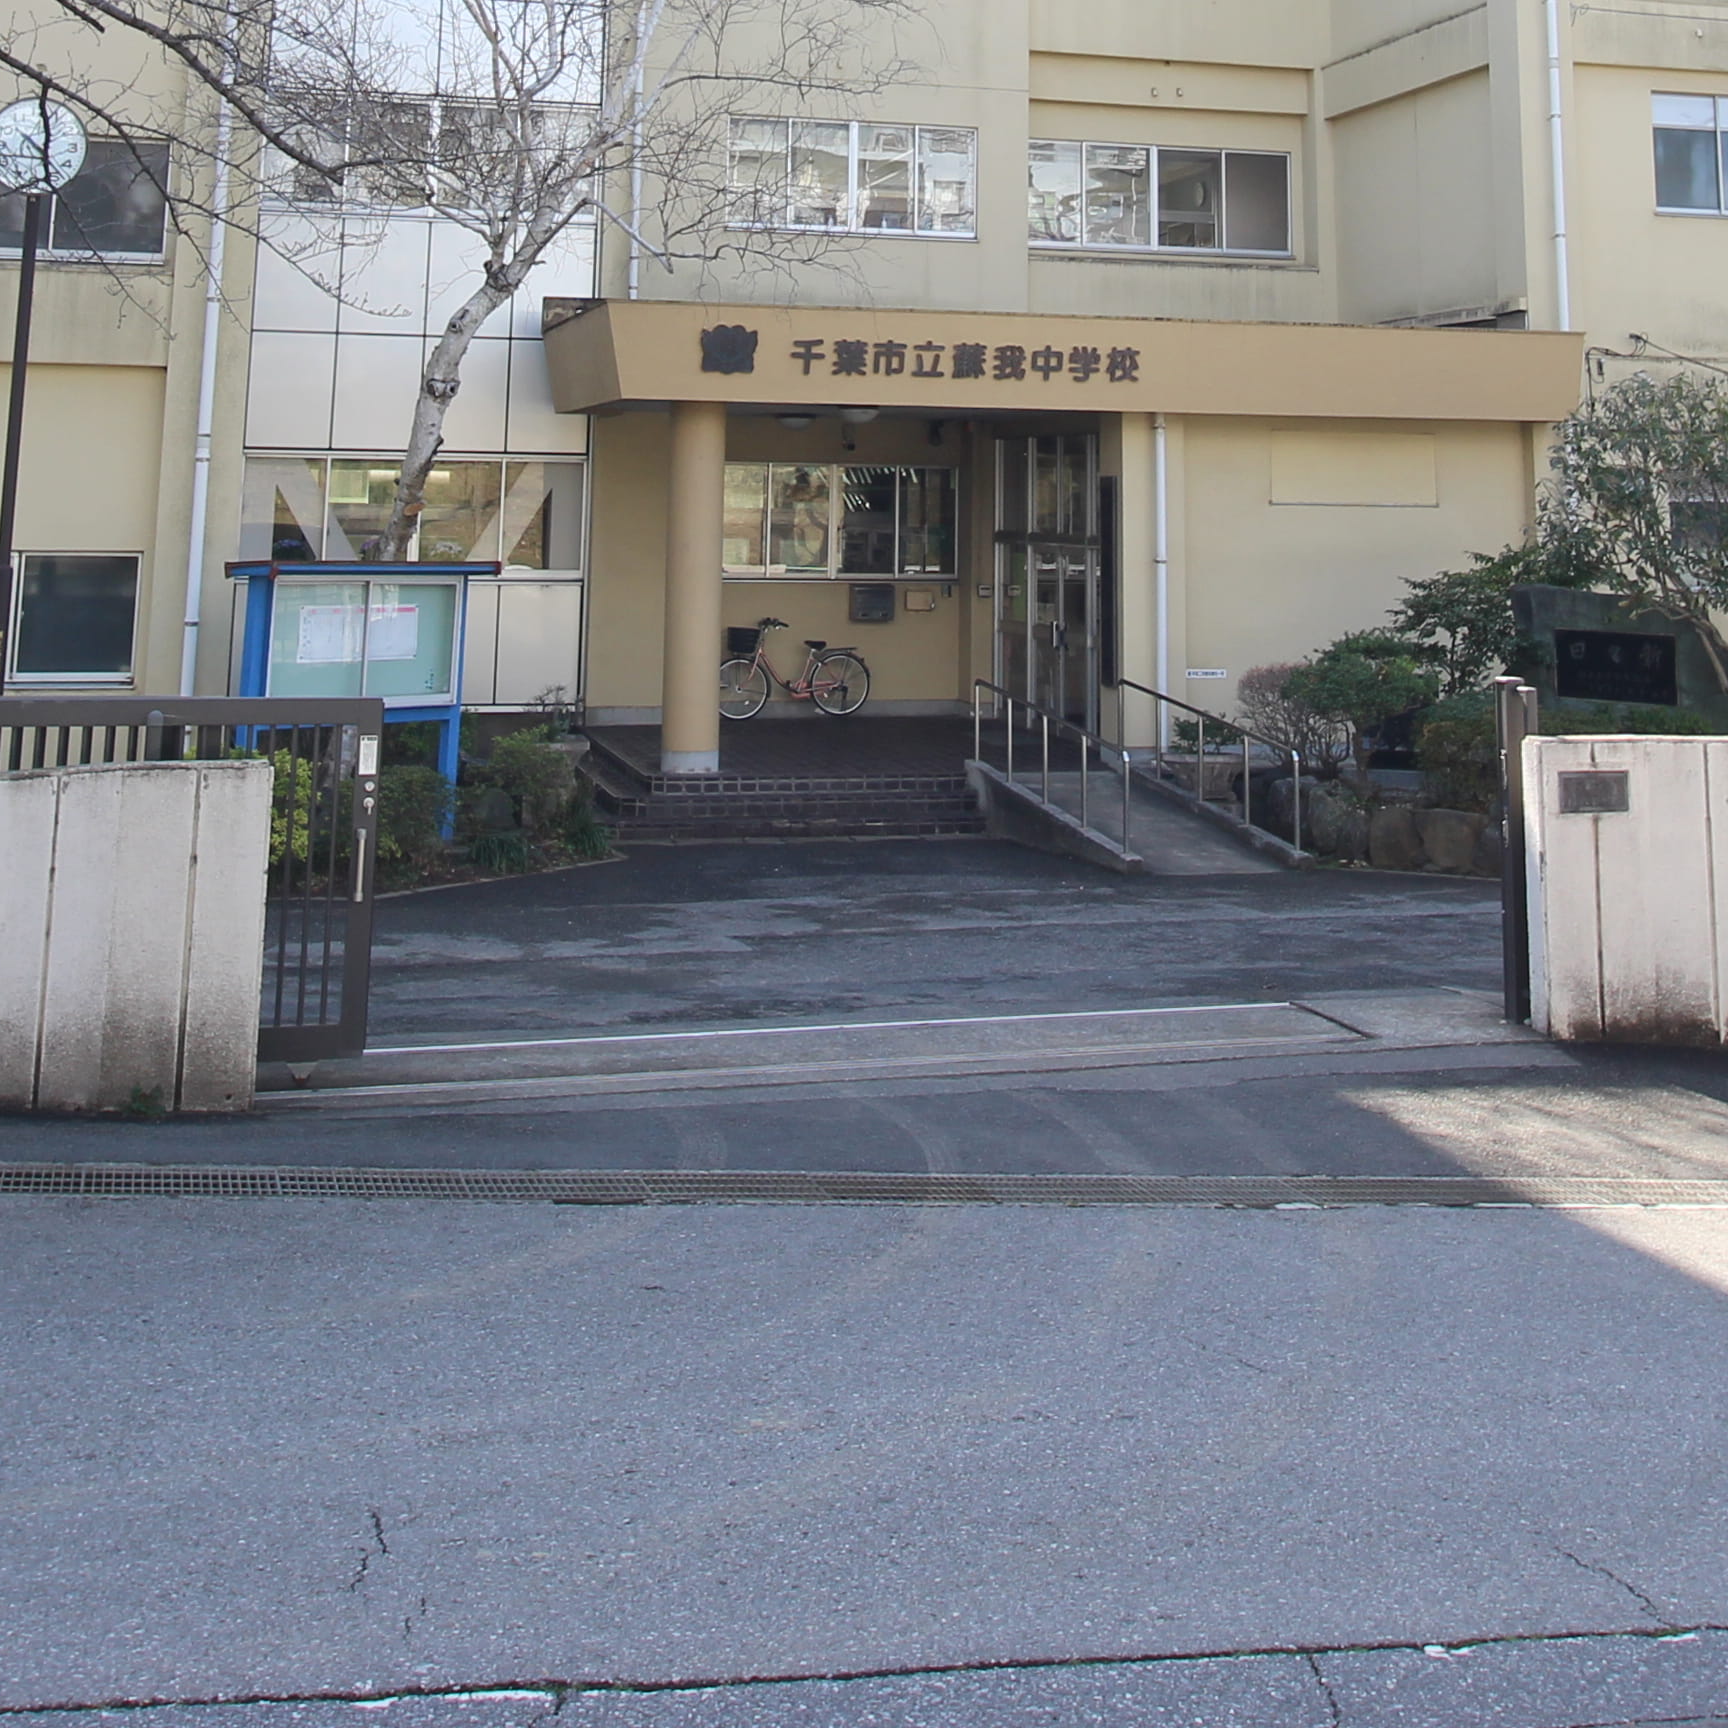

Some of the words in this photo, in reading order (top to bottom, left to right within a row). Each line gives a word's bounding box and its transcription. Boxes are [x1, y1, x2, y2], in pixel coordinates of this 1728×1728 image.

[790, 338, 1141, 383] 千葉市立蘇我中学校
